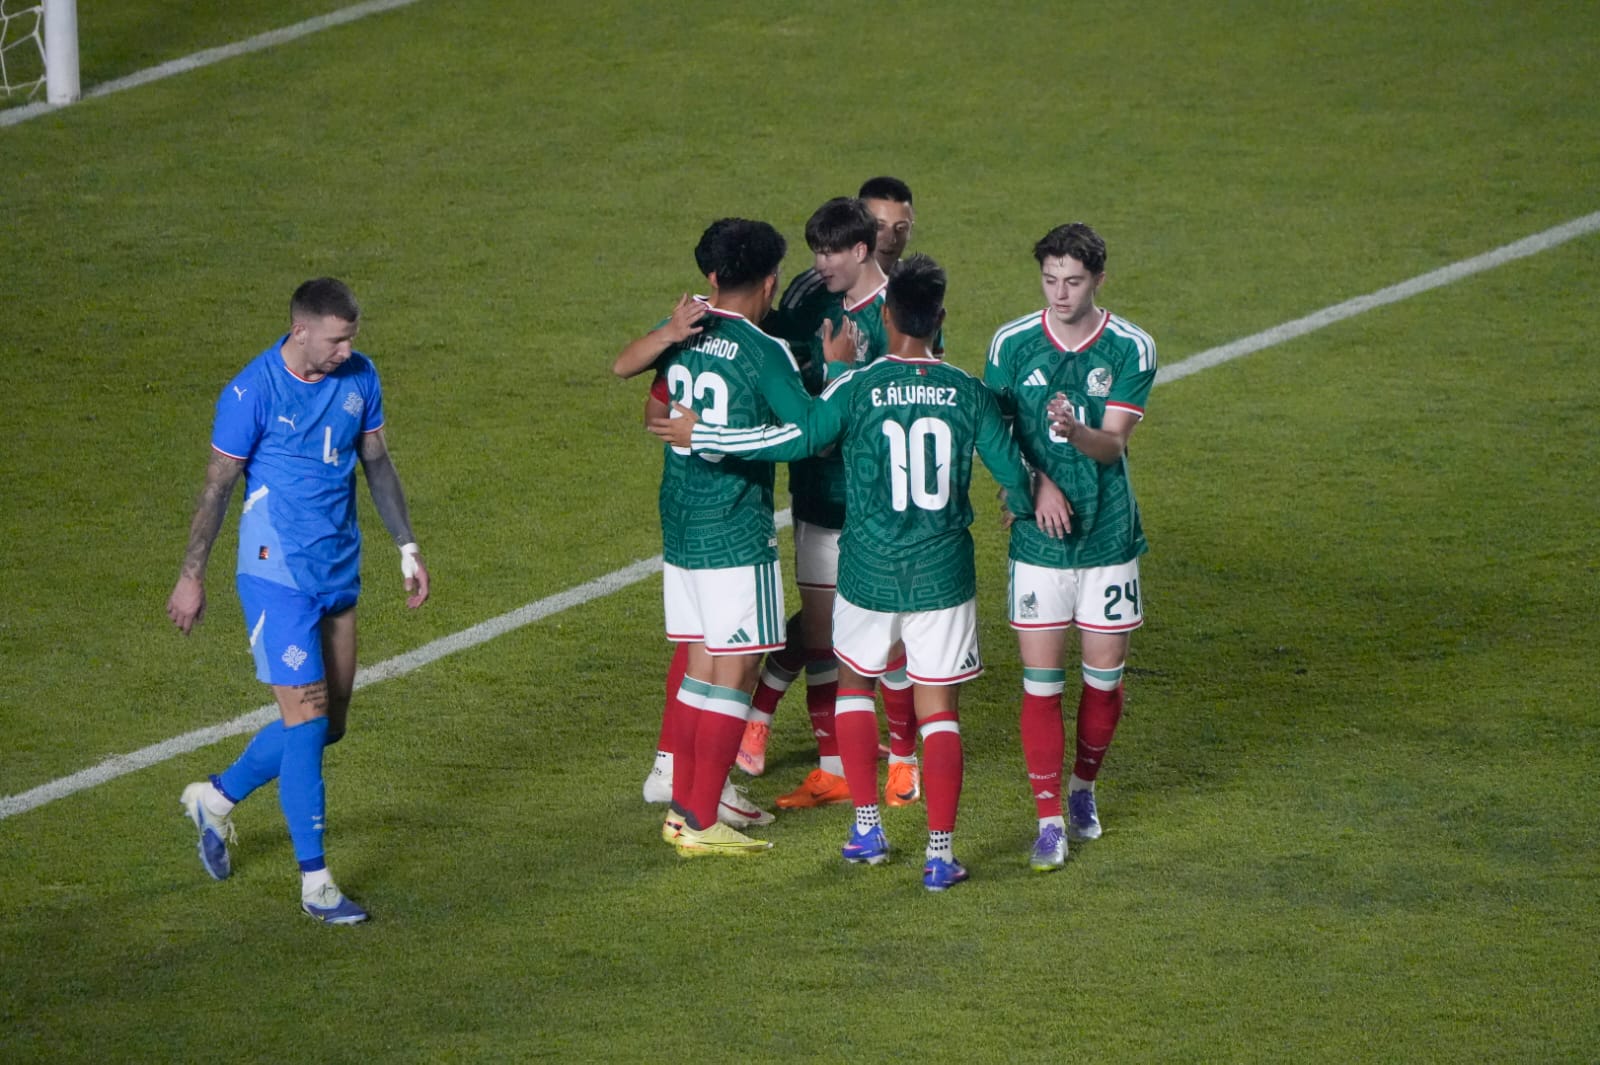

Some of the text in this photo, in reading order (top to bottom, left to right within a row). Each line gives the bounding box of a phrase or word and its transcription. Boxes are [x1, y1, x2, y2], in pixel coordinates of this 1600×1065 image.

[682, 334, 739, 360] LLARDO
[322, 426, 339, 467] 4
[882, 417, 951, 512] 10
[1104, 579, 1139, 621] 24
